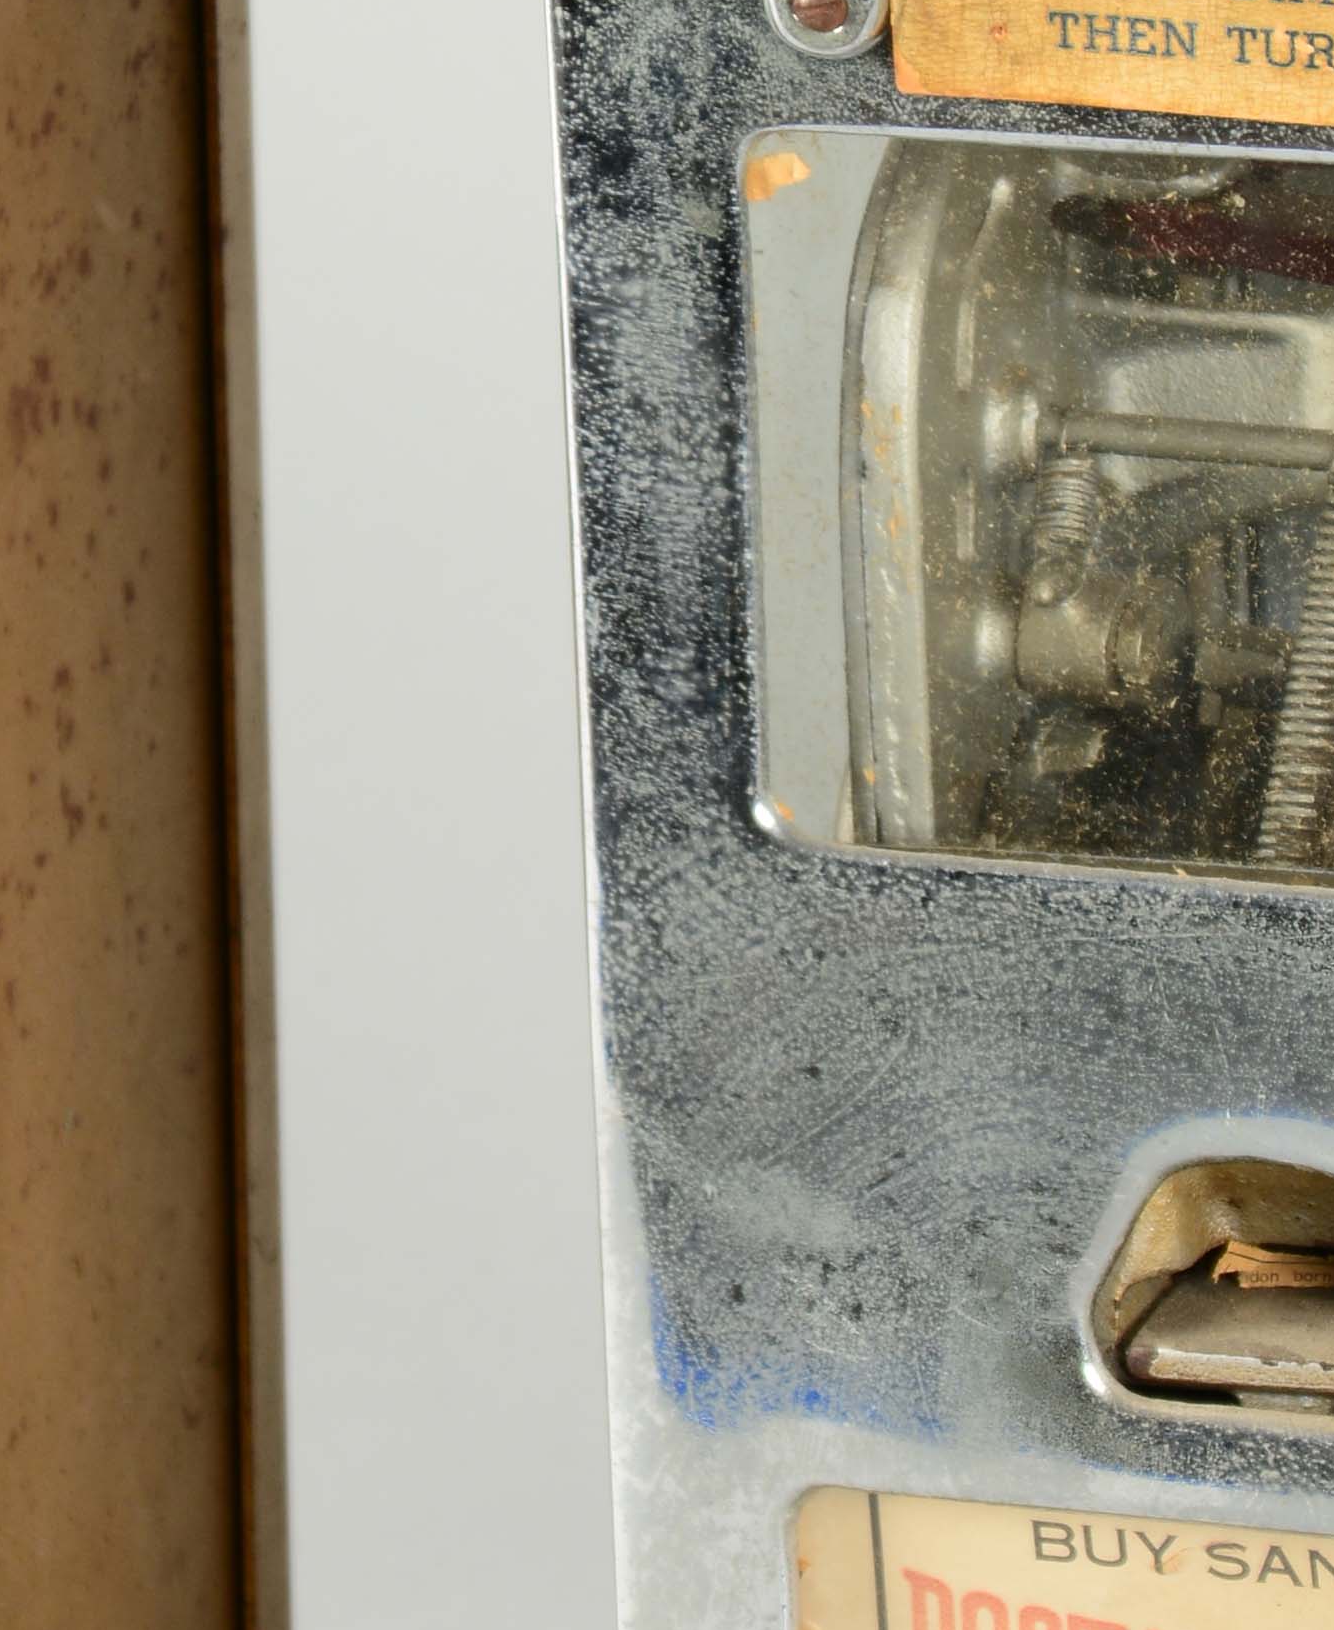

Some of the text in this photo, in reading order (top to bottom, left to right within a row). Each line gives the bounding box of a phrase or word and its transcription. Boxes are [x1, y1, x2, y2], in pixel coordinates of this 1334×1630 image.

[1048, 11, 1197, 59] THEN
[1293, 1269, 1332, 1283] born
[1031, 1520, 1177, 1575] BUY
